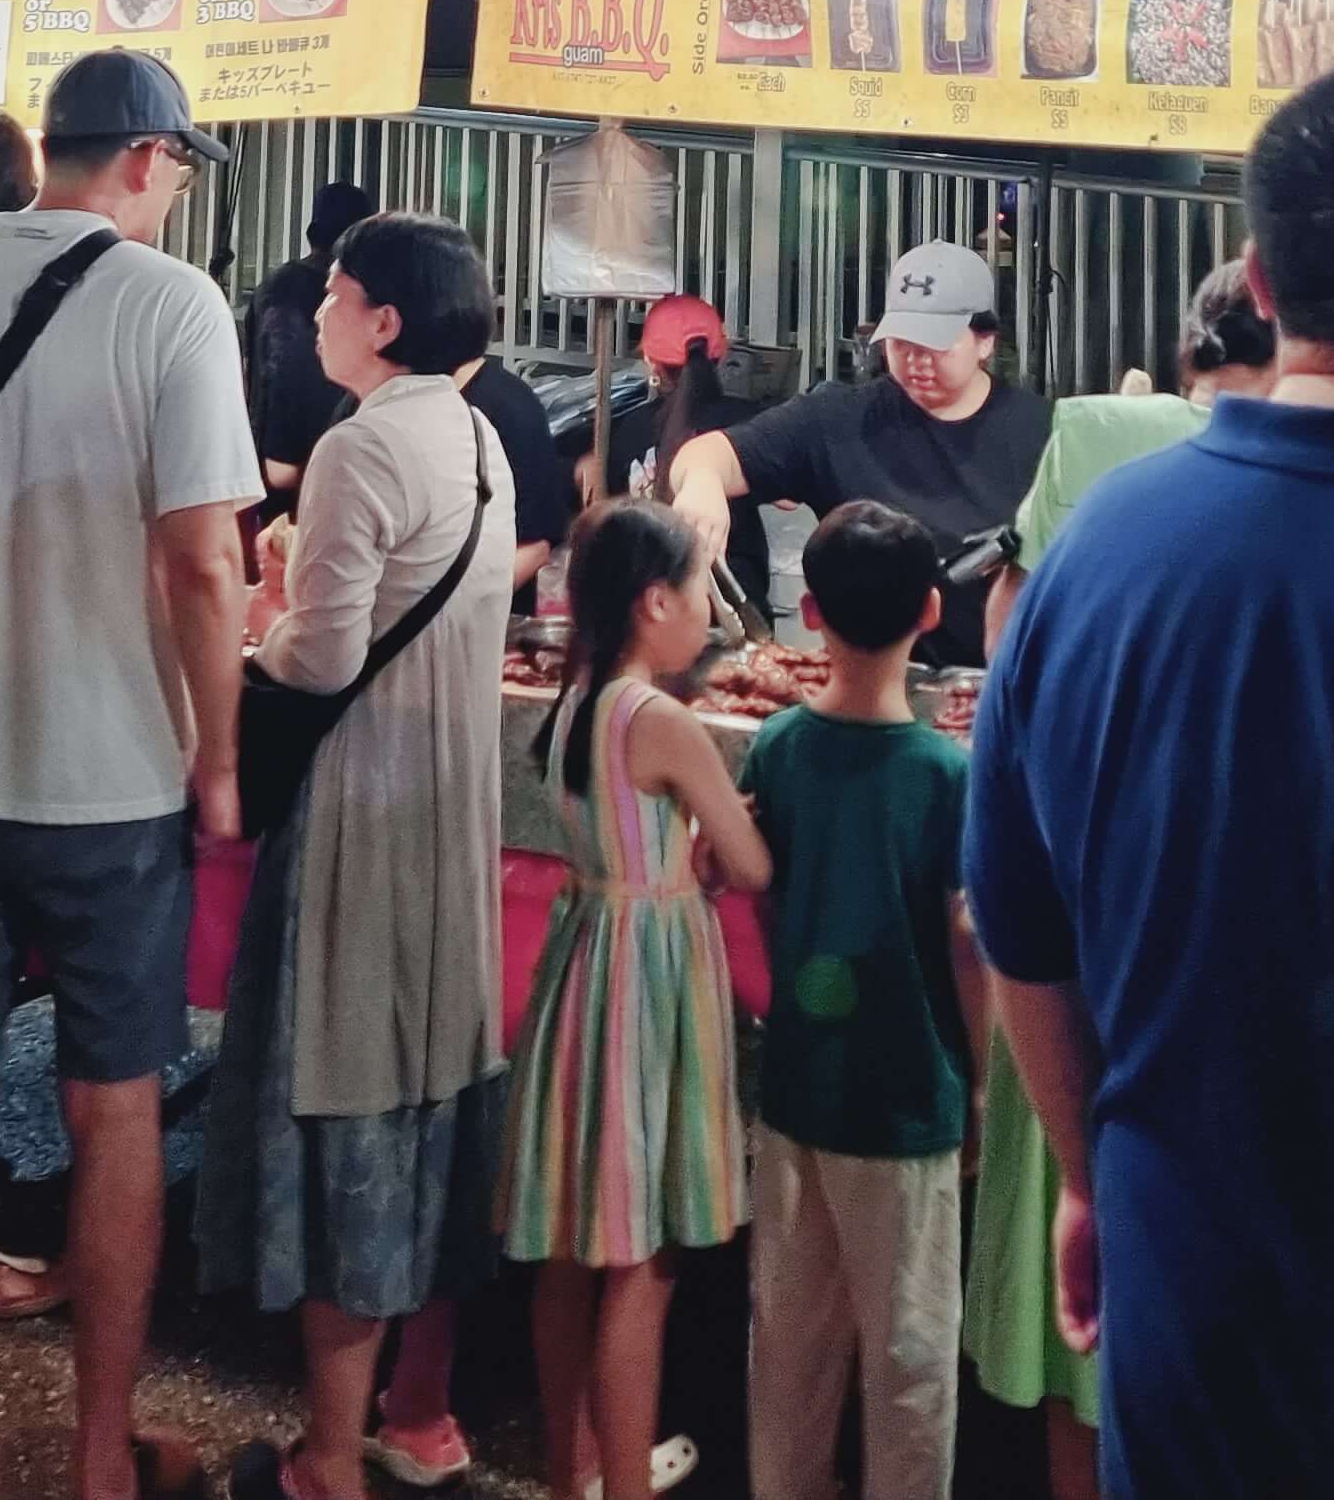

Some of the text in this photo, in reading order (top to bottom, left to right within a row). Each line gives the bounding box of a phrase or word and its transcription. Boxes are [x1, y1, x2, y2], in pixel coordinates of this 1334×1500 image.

[22, 10, 94, 33] 5 BBQ
[195, 3, 212, 25] 3
[562, 44, 606, 69] guam
[691, 30, 708, 77] Side
[849, 75, 884, 98] Squid
[946, 80, 977, 102] Corn
